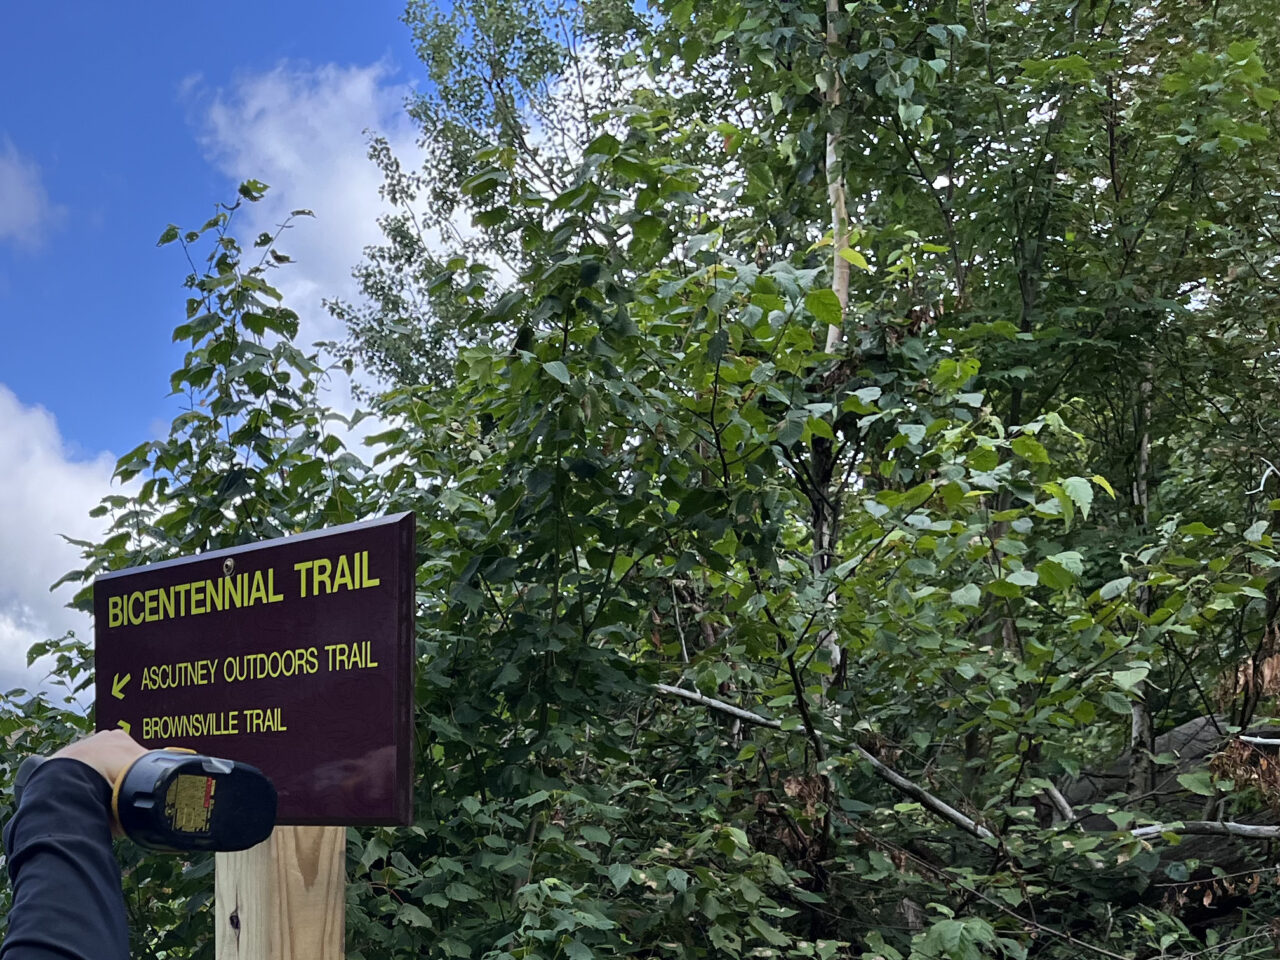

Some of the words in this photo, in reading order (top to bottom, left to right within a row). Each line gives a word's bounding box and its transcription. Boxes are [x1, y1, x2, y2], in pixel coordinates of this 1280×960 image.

[108, 568, 284, 628] BICENTENNIAL
[294, 551, 380, 598] TRAIL
[141, 659, 218, 690] ASCUTNEY
[223, 647, 318, 683] OUTDOORS
[324, 641, 378, 672] TRAIL
[143, 711, 239, 739] BROWNSVILLE
[244, 708, 287, 733] TRAIL
